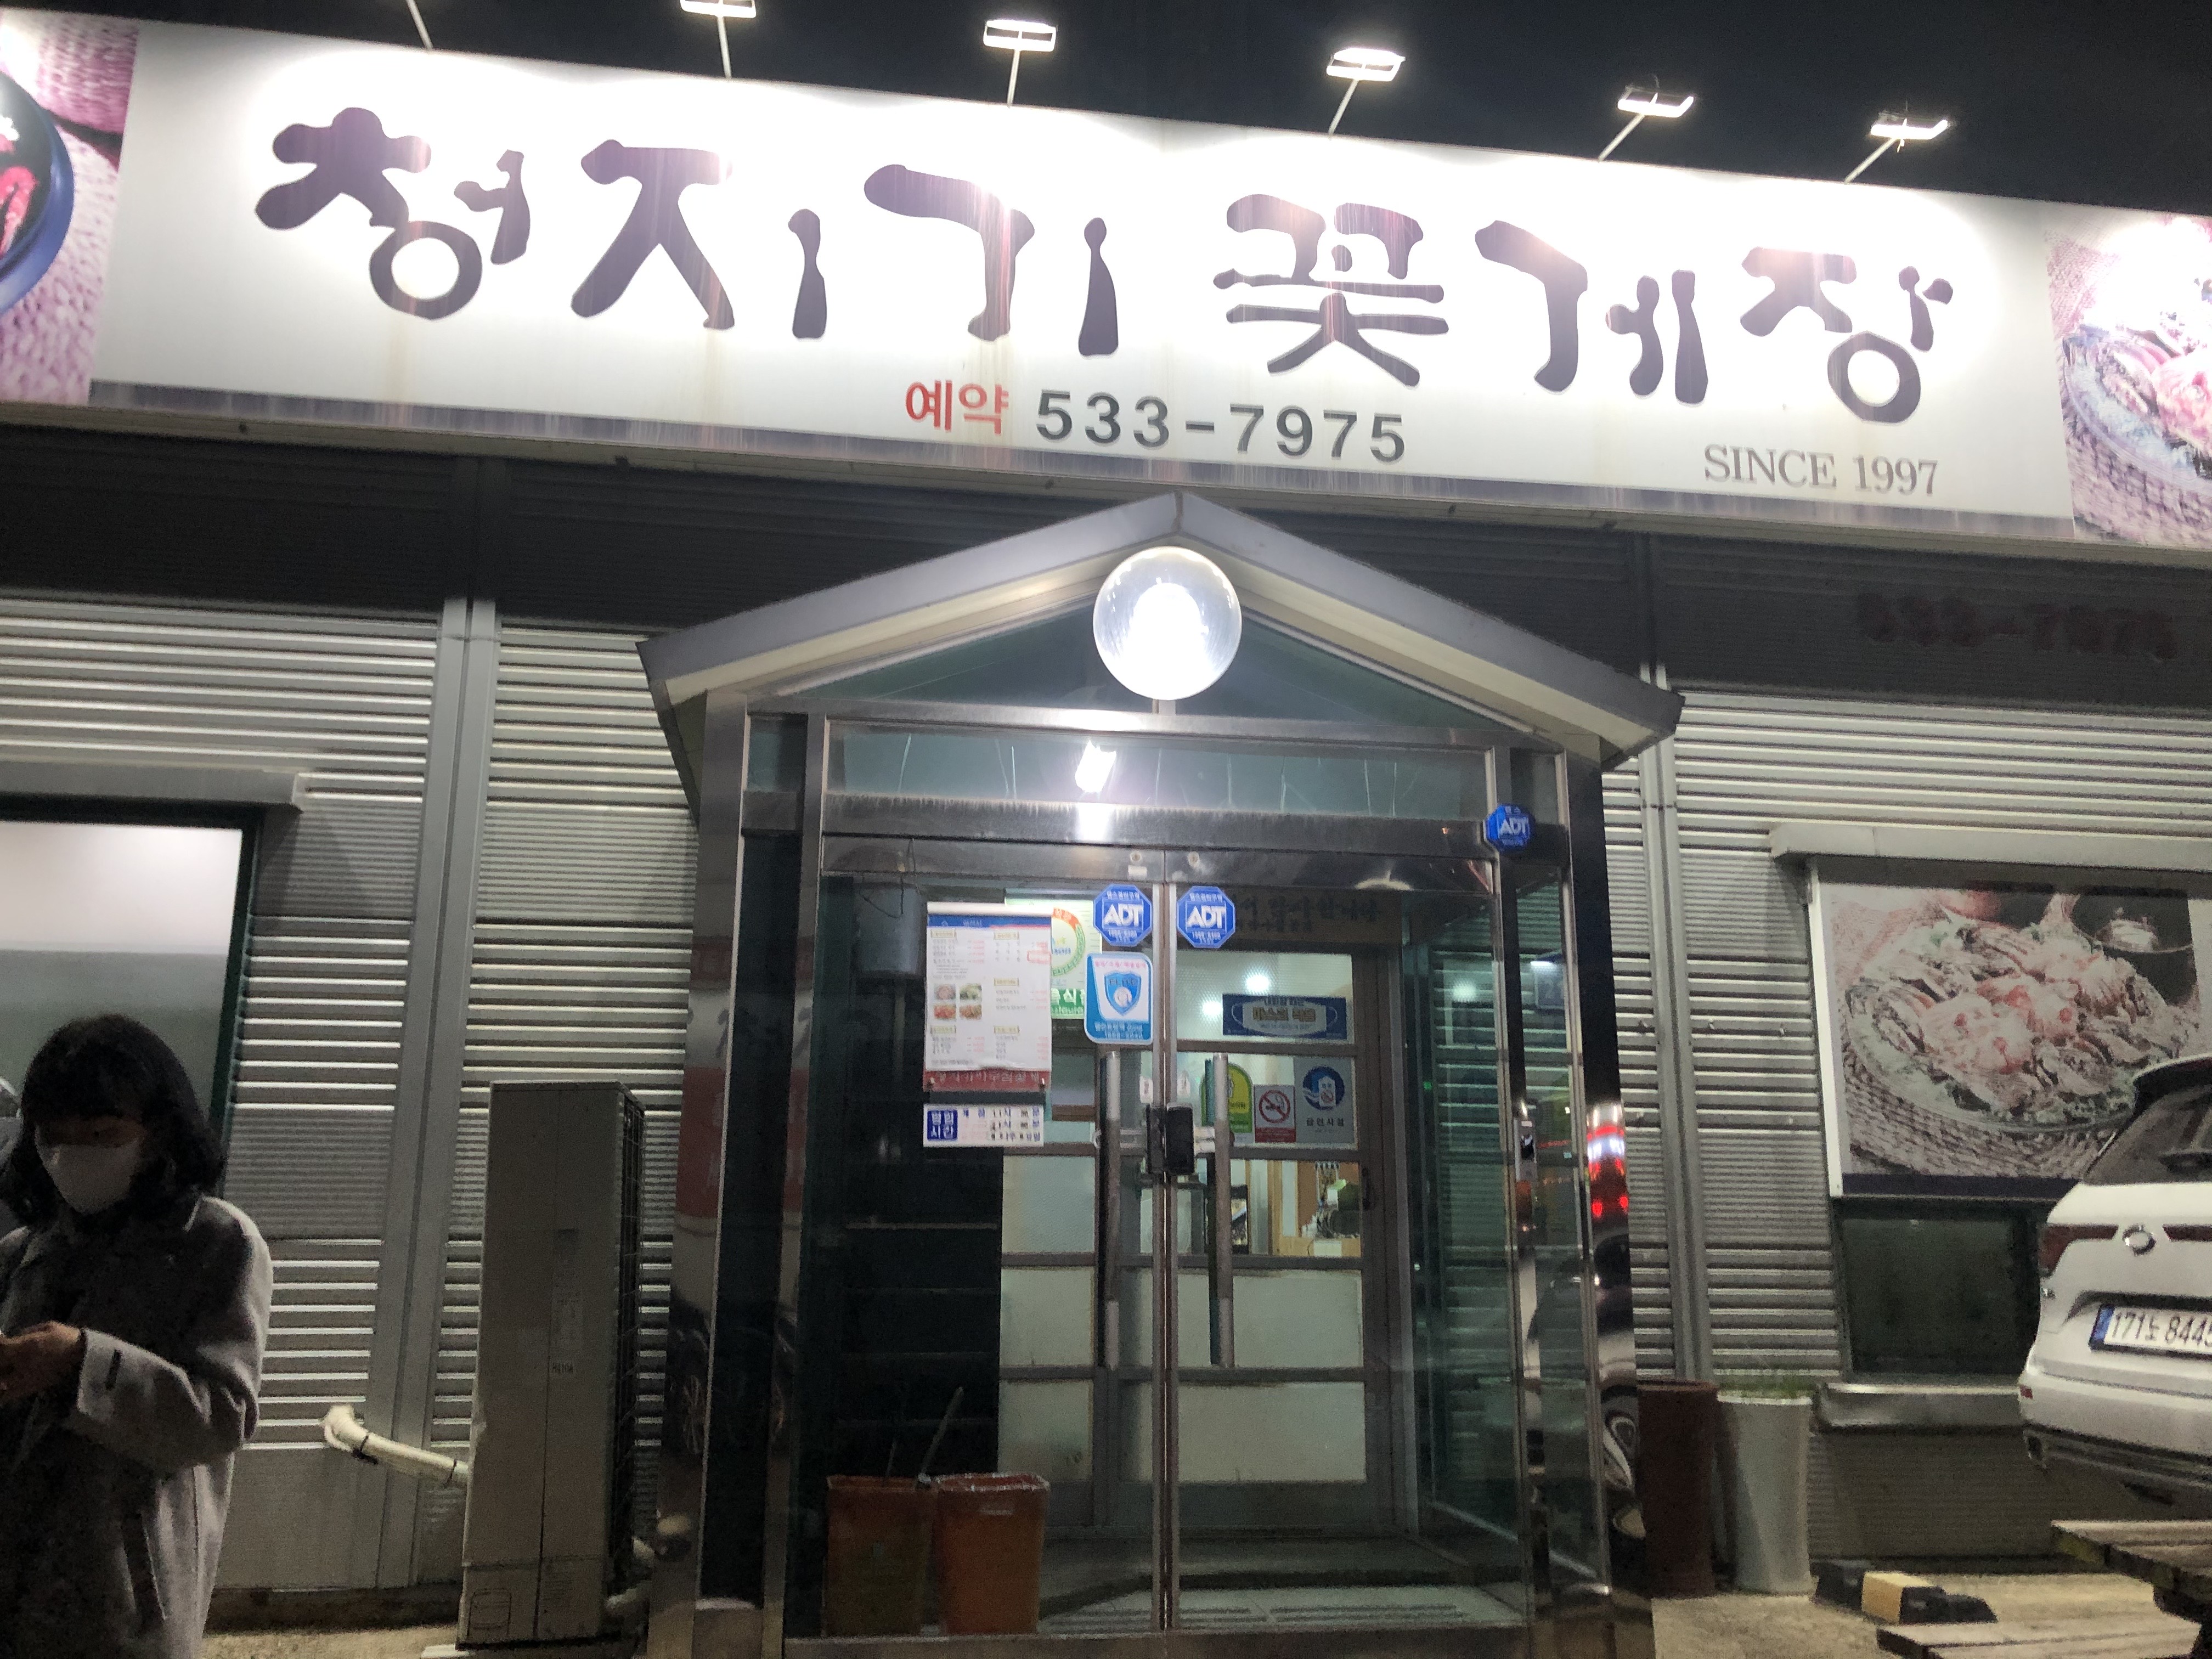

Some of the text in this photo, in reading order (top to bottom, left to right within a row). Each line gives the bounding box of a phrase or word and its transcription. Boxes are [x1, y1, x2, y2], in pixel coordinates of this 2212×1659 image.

[255, 107, 1953, 424] 청지기 꽃게장
[905, 380, 1405, 462] 예약 533-7975
[1704, 444, 1939, 496] SINCE 1997
[1498, 817, 1528, 835] ADT
[1104, 903, 1143, 927] ADT
[1187, 905, 1226, 928] ADT
